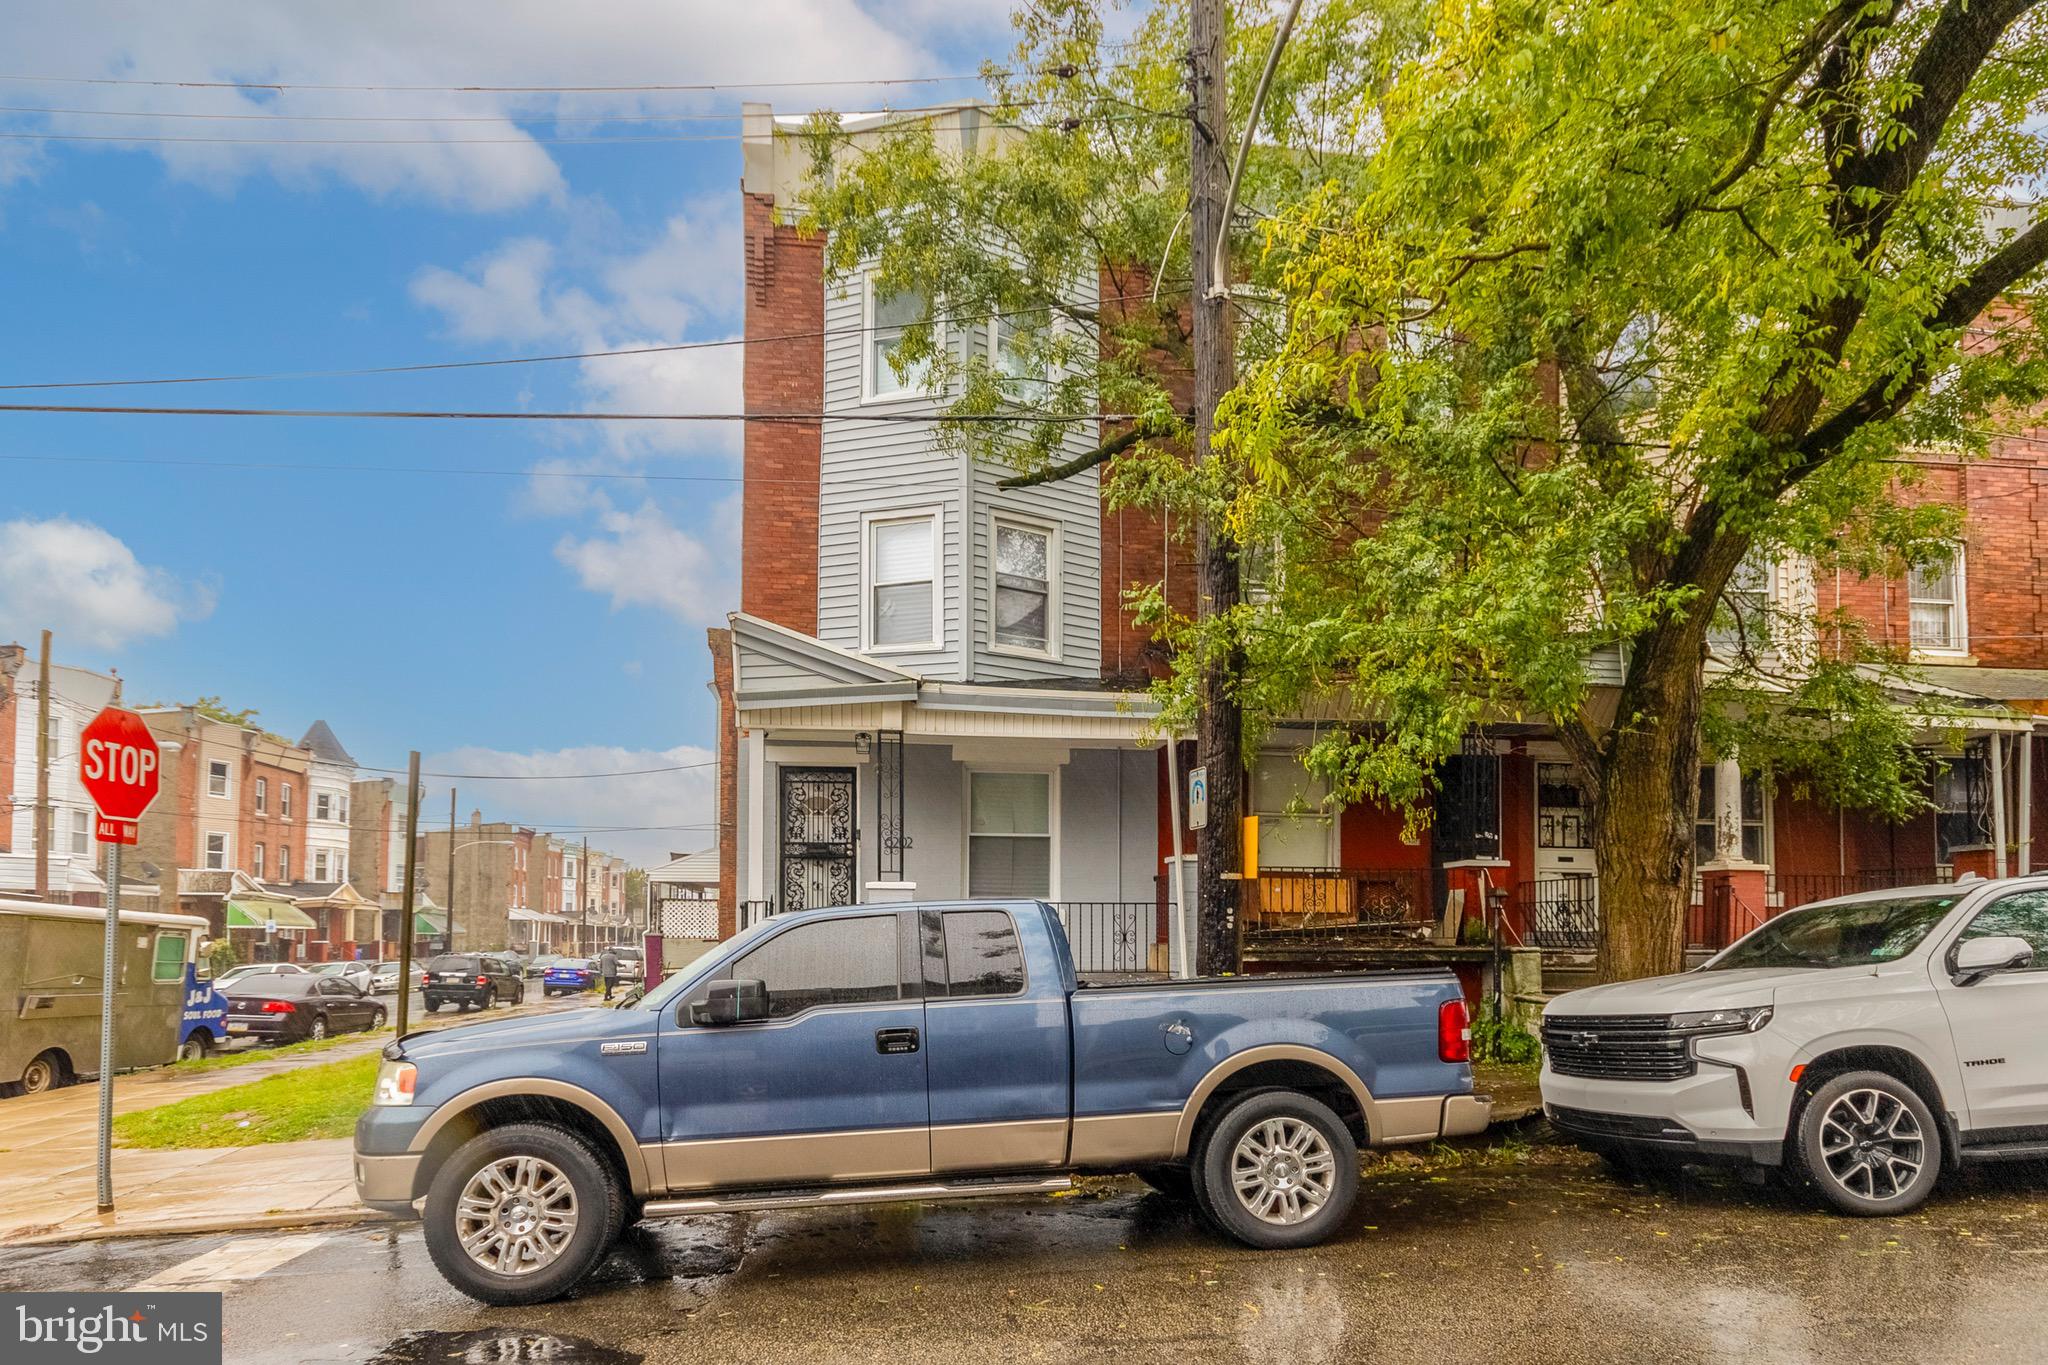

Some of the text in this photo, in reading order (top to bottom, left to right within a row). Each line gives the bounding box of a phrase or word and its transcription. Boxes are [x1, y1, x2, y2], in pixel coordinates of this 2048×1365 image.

[84, 738, 156, 787] STOP
[98, 822, 117, 836] ALL
[187, 987, 211, 1006] J&J
[183, 1009, 222, 1020] SOUL FOOD
[1963, 1057, 2006, 1067] TAHOE
